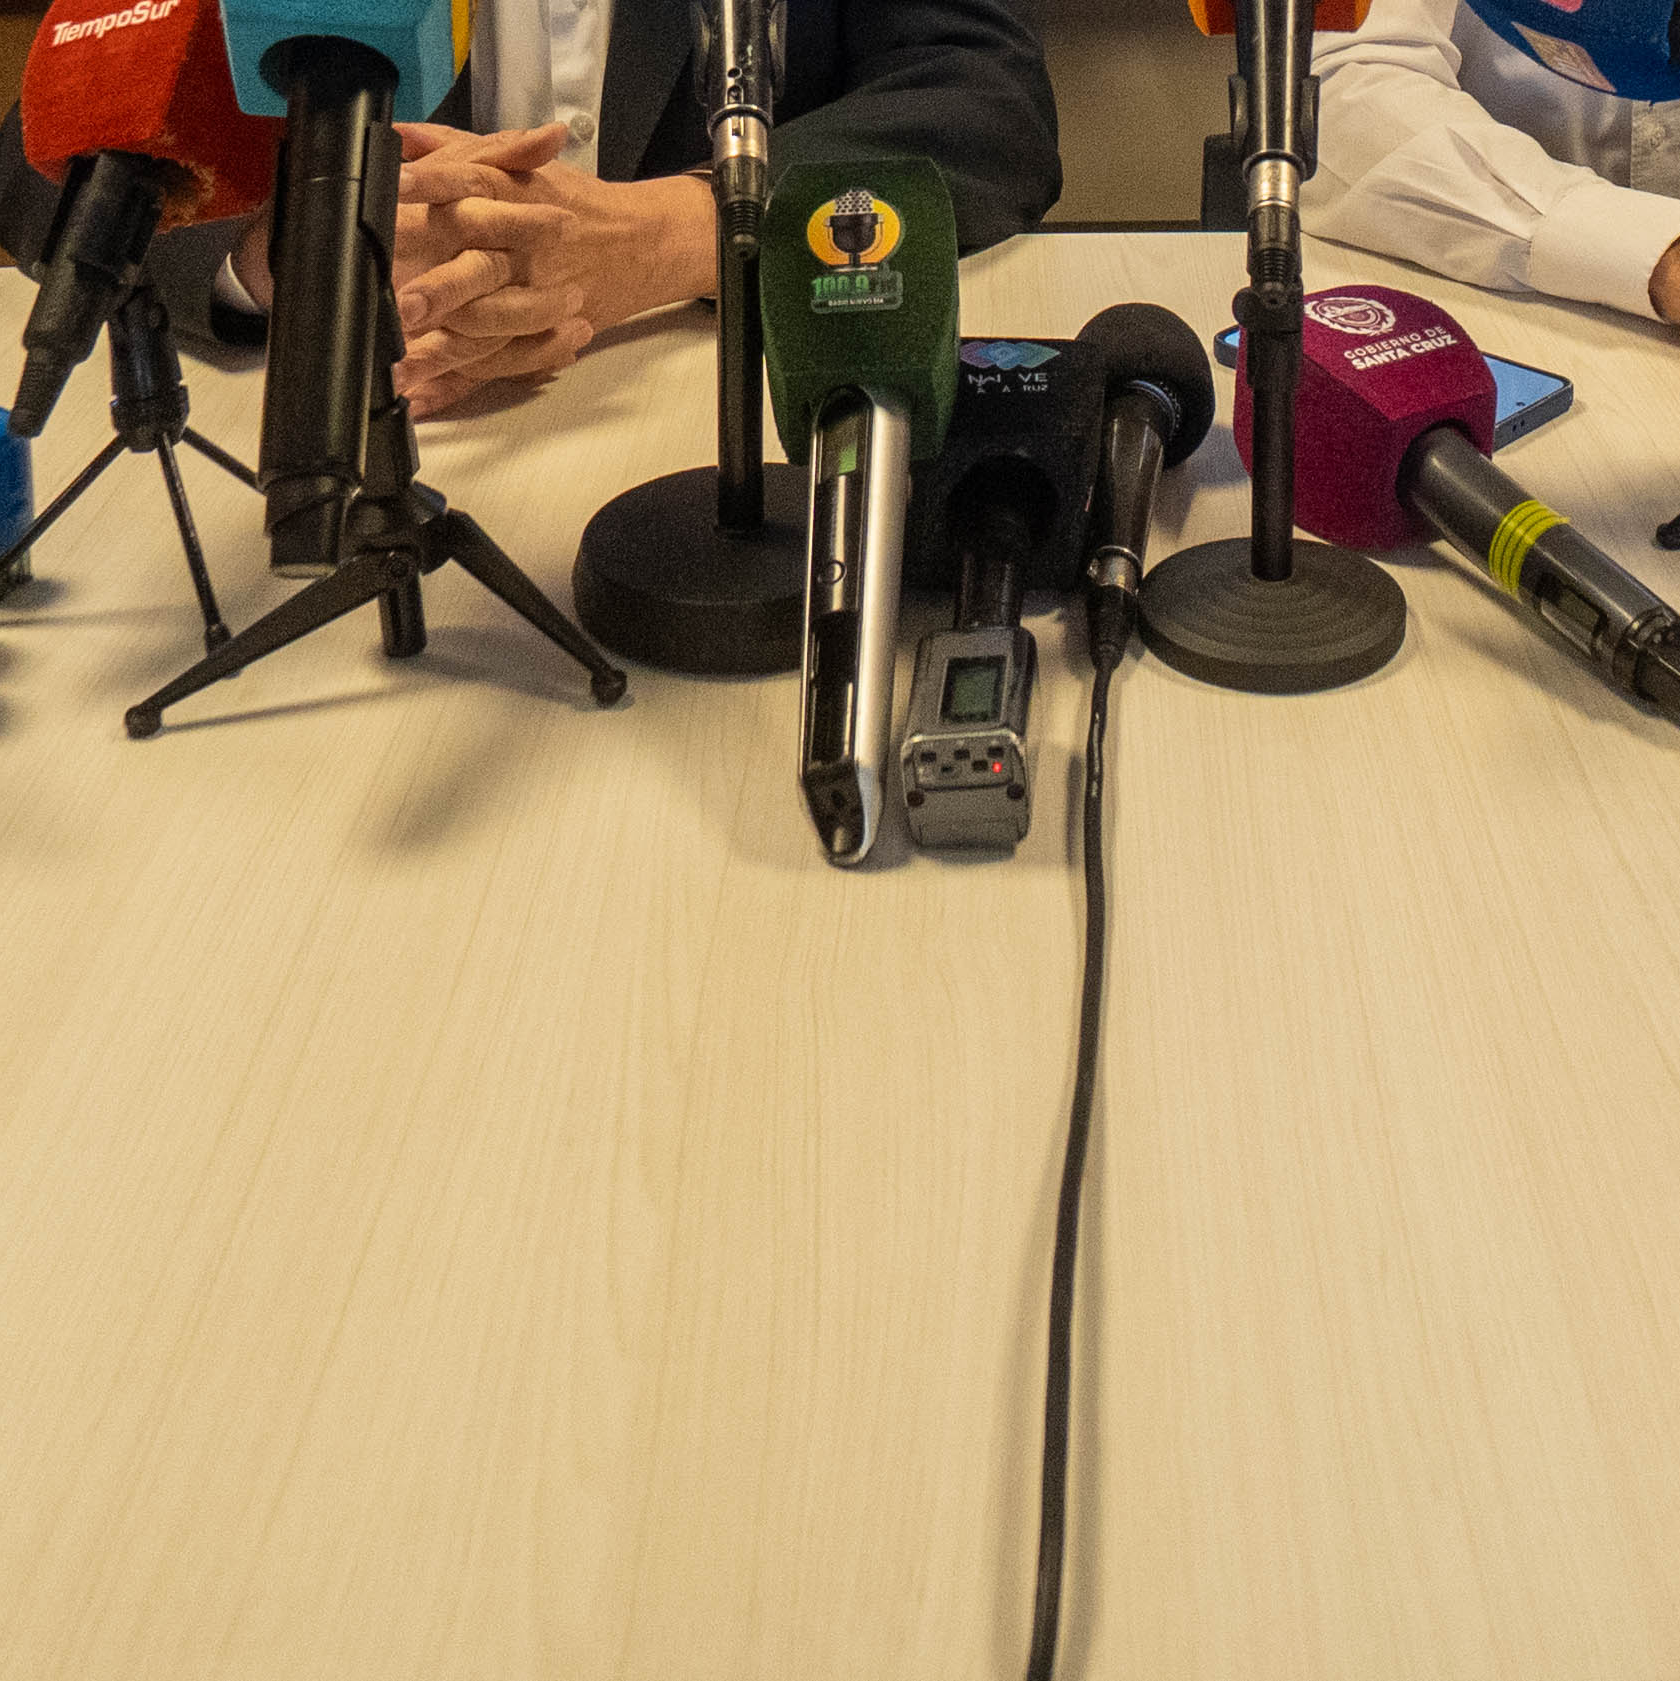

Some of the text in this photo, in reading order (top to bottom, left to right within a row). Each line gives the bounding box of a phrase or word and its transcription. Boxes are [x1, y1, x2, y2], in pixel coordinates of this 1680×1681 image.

[1344, 325, 1447, 359] GOBIERNO DE
[1351, 334, 1458, 370] SANTA CRUZ
